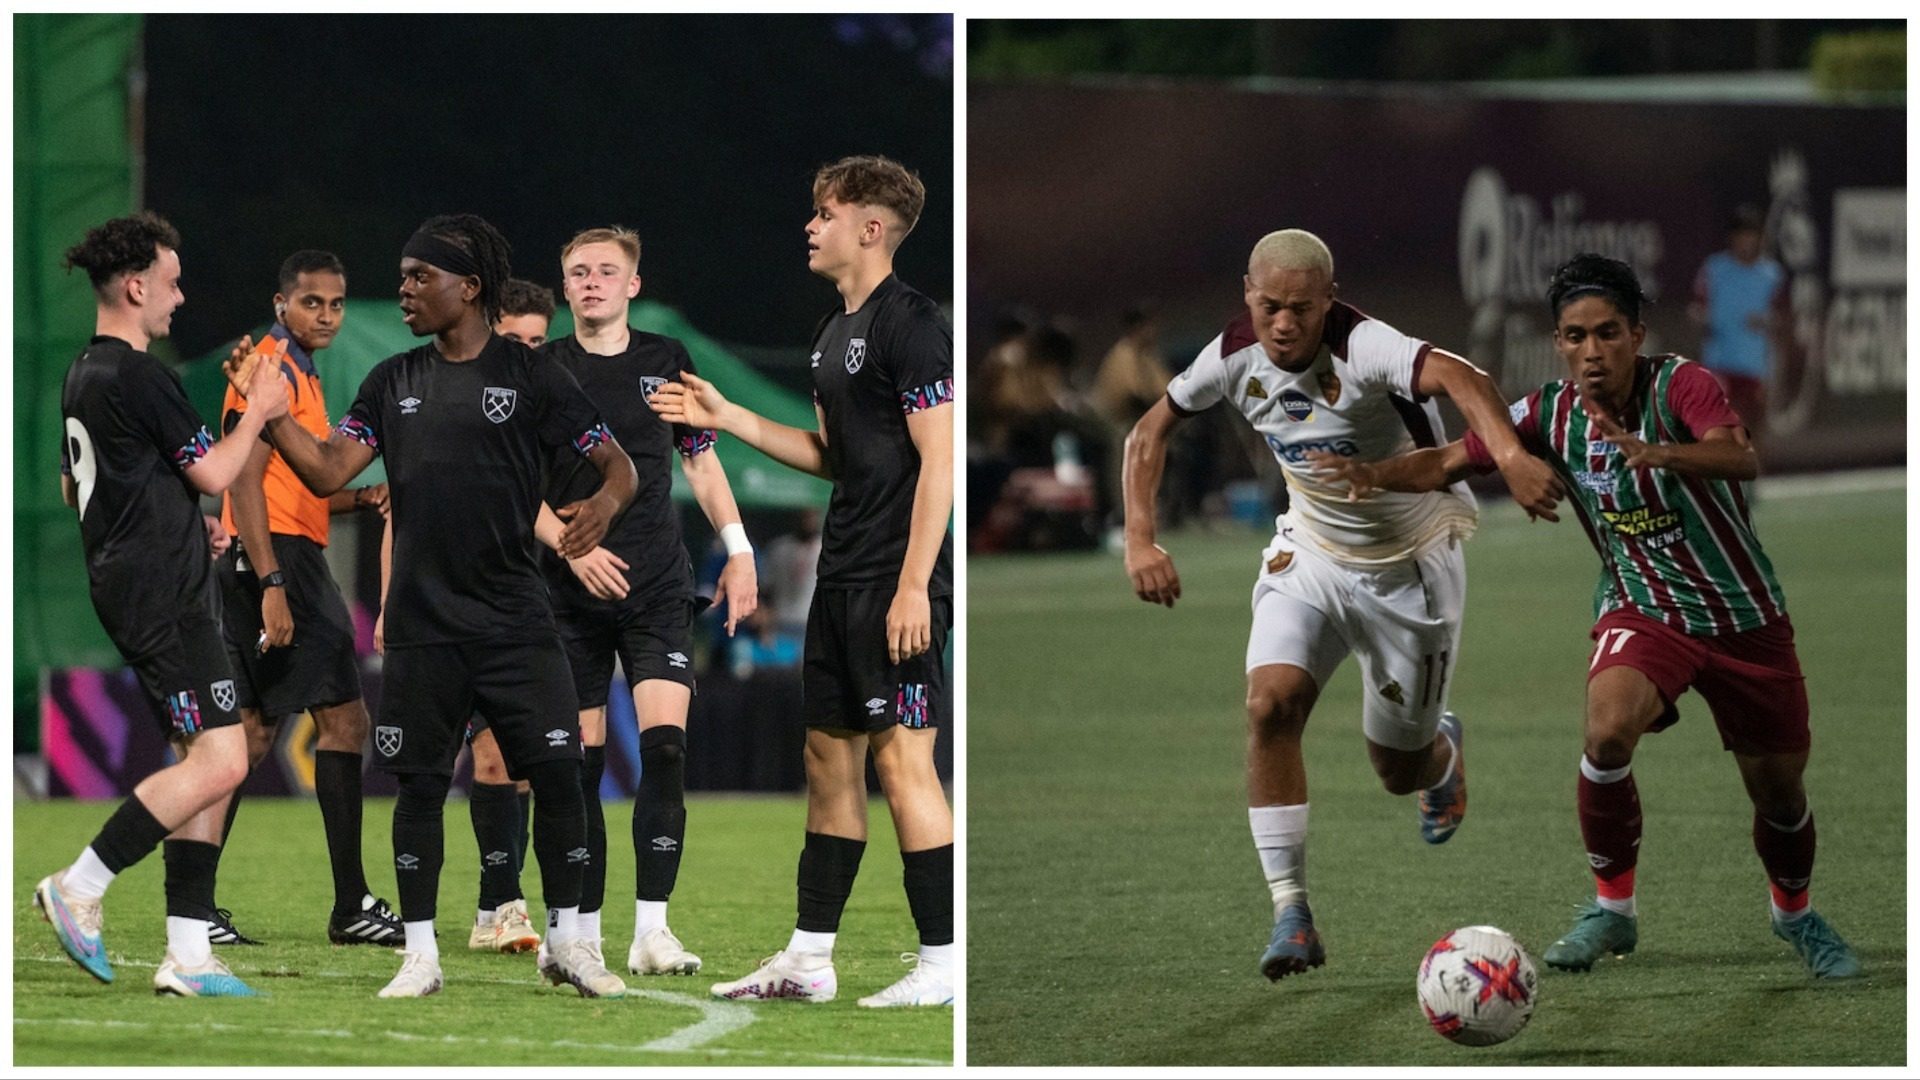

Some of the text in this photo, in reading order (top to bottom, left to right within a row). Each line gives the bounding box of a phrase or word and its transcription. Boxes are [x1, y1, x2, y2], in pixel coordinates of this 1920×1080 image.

[1602, 507, 1649, 523] PARI
[1614, 512, 1680, 536] MATCH
[1646, 527, 1684, 549] NEWS
[1590, 628, 1638, 671] 17
[1422, 650, 1448, 709] 11
